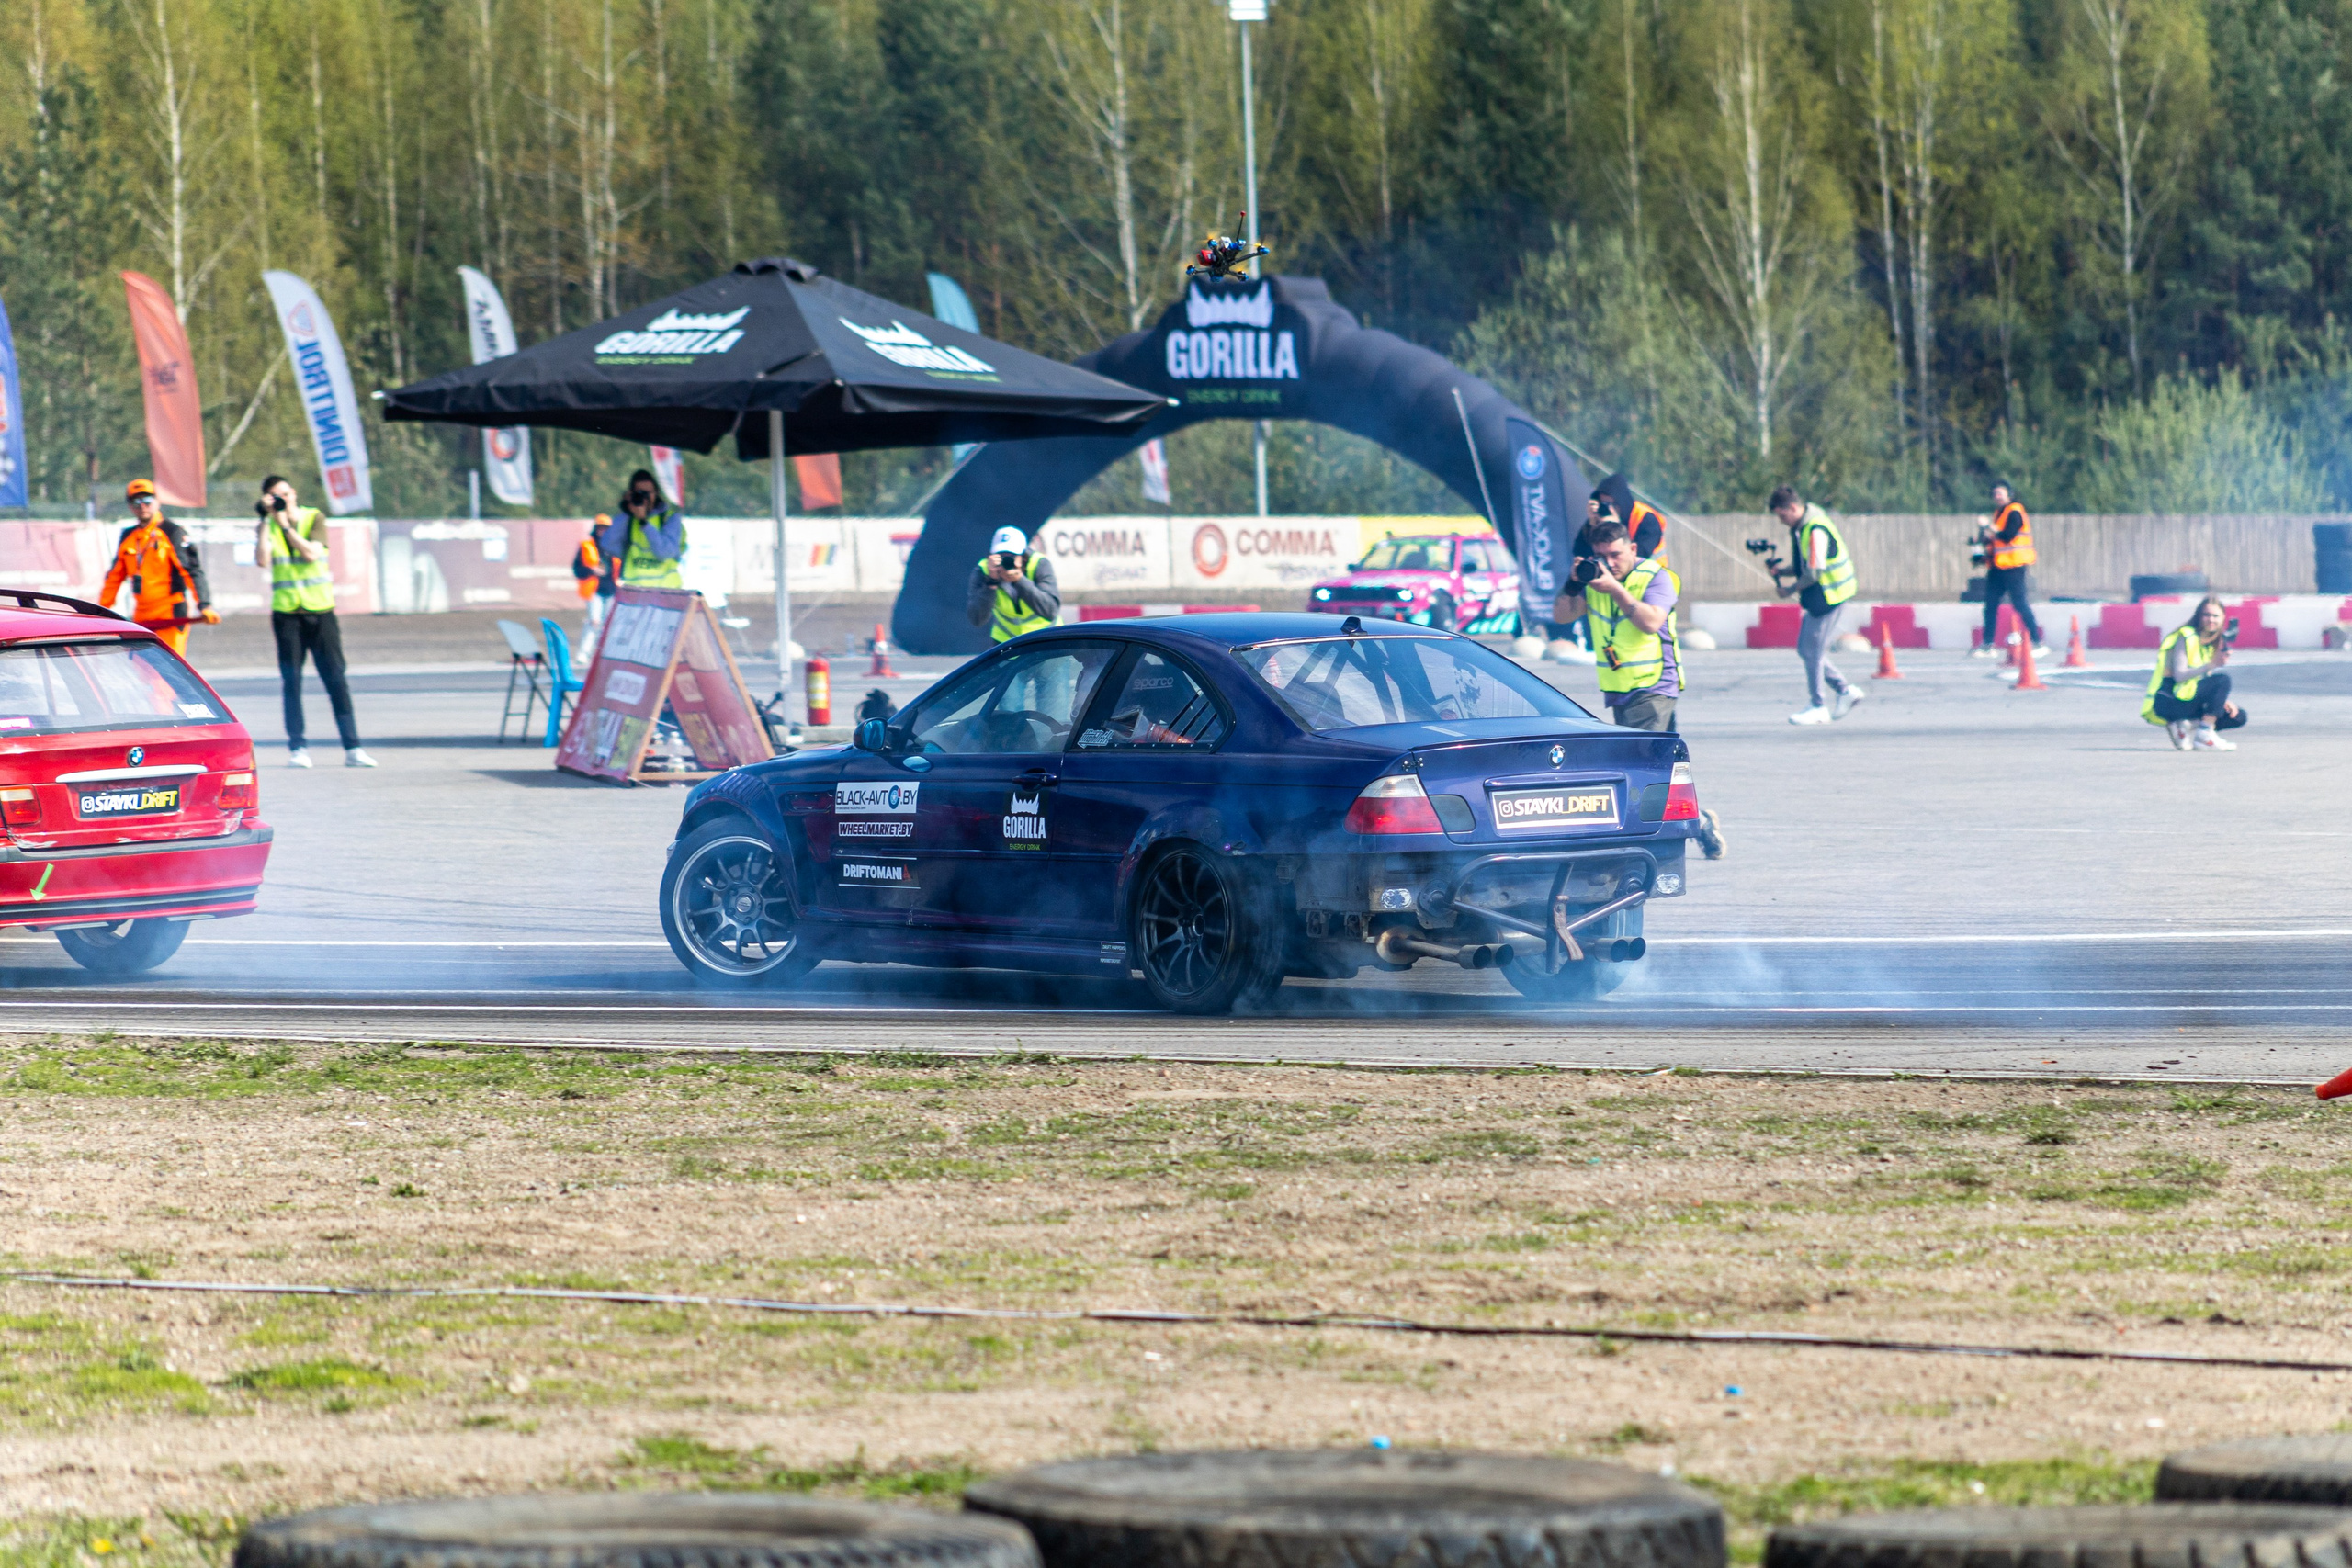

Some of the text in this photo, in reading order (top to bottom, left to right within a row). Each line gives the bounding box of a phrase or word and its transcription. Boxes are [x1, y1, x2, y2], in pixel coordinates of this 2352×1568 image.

[594, 329, 745, 354] GORILLA
[1167, 330, 1300, 379] GORILLA
[1055, 530, 1145, 557] COMMA
[1236, 528, 1336, 556] COMMA
[1134, 676, 1174, 691] sparco
[94, 790, 178, 813] STAYKI_DRIFT
[1514, 795, 1609, 816] STAYKI_DRIFT
[1003, 816, 1046, 839] GORILLA
